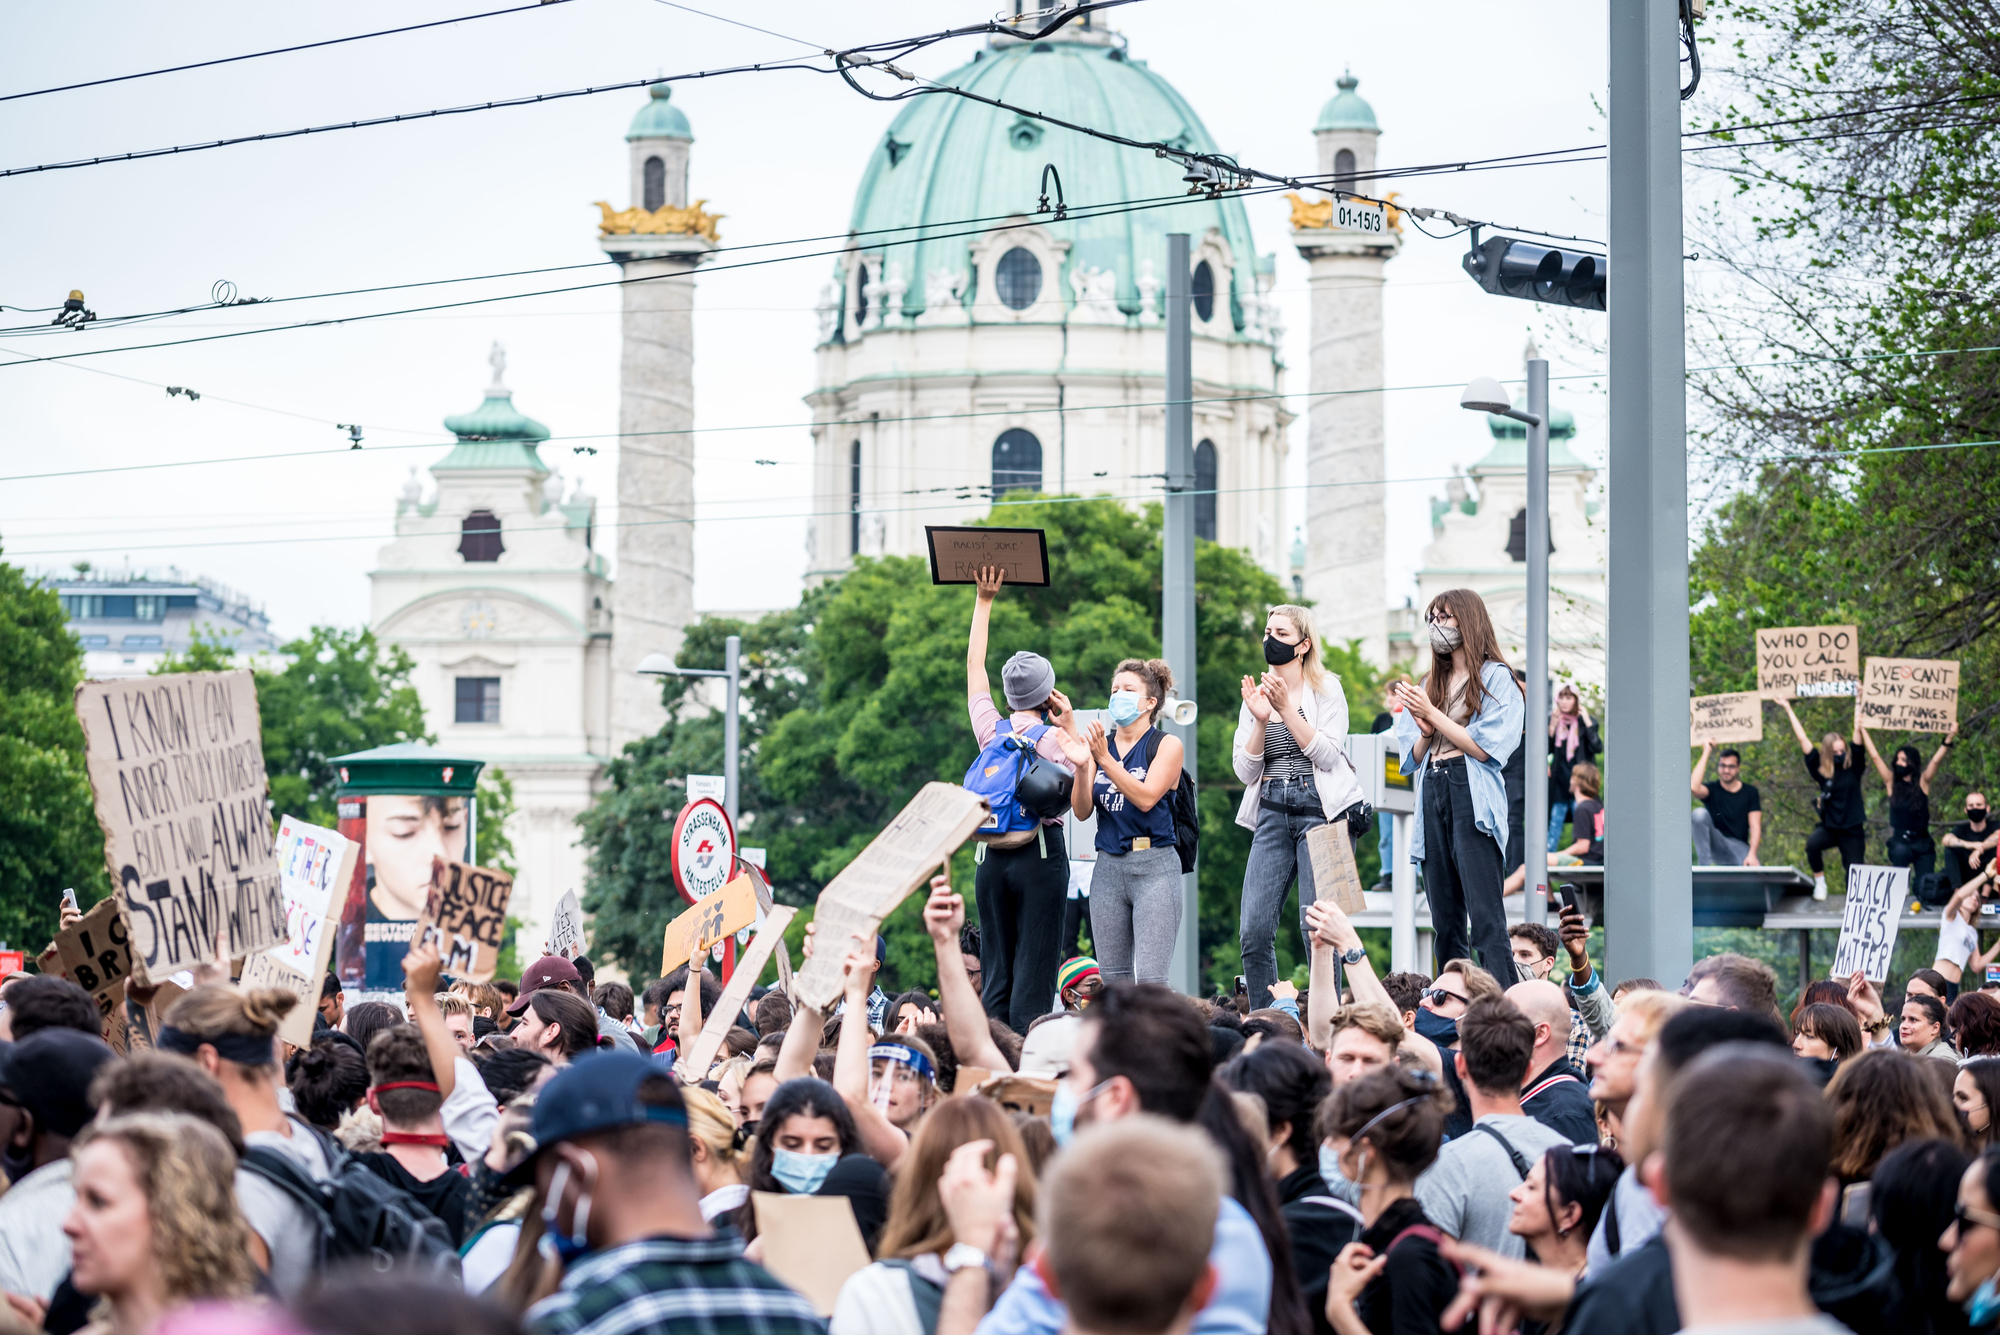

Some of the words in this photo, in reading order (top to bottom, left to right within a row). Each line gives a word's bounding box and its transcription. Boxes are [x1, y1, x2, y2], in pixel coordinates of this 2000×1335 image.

[1339, 206, 1381, 232] 01-15/3
[982, 533, 990, 541] A
[982, 552, 993, 561] IS
[954, 561, 1023, 579] RACST
[1761, 633, 1808, 649] WHO
[1818, 632, 1850, 650] DO
[1762, 652, 1798, 670] YOU
[1803, 650, 1847, 666] CALL
[1761, 672, 1800, 690] WHEN
[1803, 669, 1827, 684] THE
[1872, 665, 1902, 681] WE
[1866, 682, 1905, 699] STAY
[1908, 685, 1957, 702] SILENT
[102, 693, 124, 761] I
[124, 685, 191, 758] KNOW
[187, 680, 200, 748] I
[203, 680, 236, 744] CAN
[1861, 700, 1895, 718] ABOUT
[1899, 705, 1948, 720] THINGS
[1694, 715, 1754, 732] RASSISMUS
[1878, 717, 1909, 728] THAT
[119, 757, 179, 826] NEVER
[172, 749, 217, 809] TRULY
[131, 822, 168, 880] BUT
[168, 819, 180, 870] I
[177, 817, 210, 867] WILL
[211, 796, 273, 878] ALWAYS
[683, 811, 728, 848] STRASSENBAHN
[444, 863, 513, 915] JUSTICE
[684, 865, 726, 895] HALTESTELLE
[1848, 867, 1897, 910] BLACK
[121, 864, 220, 968] STAND
[222, 876, 264, 954] WITH
[435, 899, 503, 948] PEACE
[1843, 904, 1888, 948] LIVES
[365, 922, 416, 932] BEETHO
[713, 943, 724, 956] 62
[1835, 937, 1889, 980] MATTER
